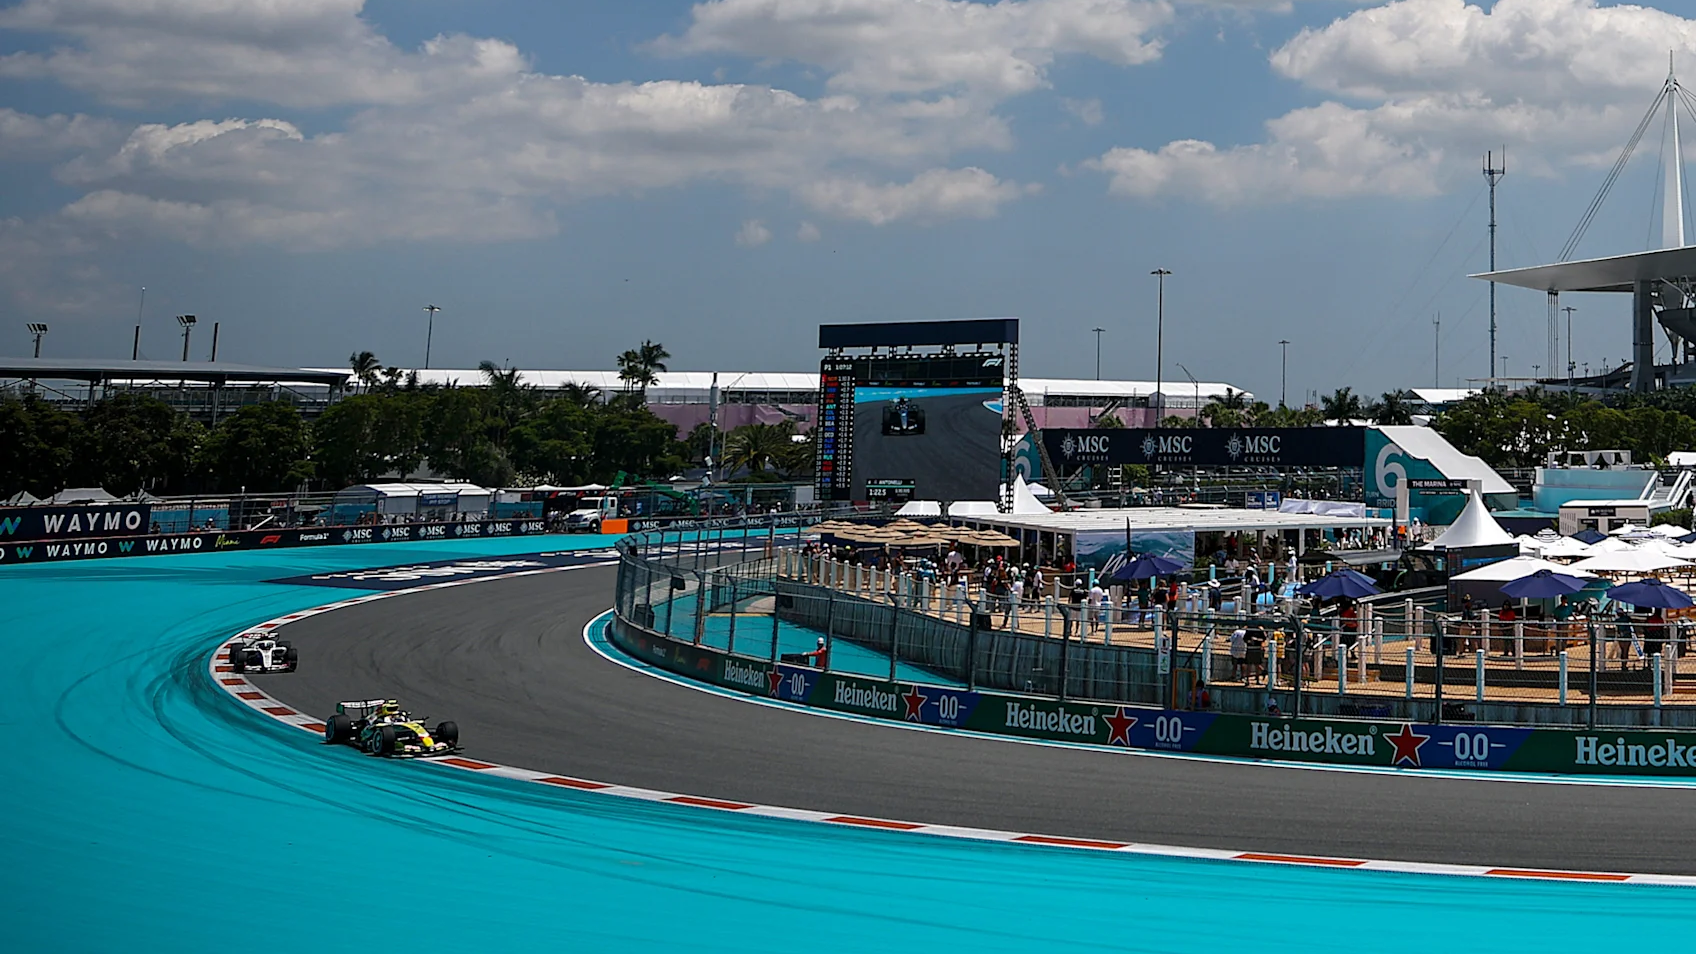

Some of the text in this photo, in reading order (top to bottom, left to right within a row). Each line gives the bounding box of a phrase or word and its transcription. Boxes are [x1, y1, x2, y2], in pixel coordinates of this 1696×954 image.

[1077, 435, 1110, 453] MSC
[1158, 436, 1192, 454] MSC
[1245, 435, 1281, 454] MSC
[1244, 455, 1281, 463] CRUISES
[1375, 443, 1407, 499] 6
[43, 511, 142, 534] WAYMO
[426, 525, 446, 535] MSC
[462, 524, 481, 534] MSC
[494, 522, 512, 532] MSC
[528, 521, 545, 531] MSC
[352, 528, 373, 539] MSC
[391, 527, 411, 537] MSC
[46, 542, 108, 558] WAYMO
[146, 537, 203, 552] WAYMO
[724, 660, 765, 688] Heineken
[834, 680, 898, 712] Heineken
[1005, 702, 1097, 735] Heineken
[1250, 722, 1375, 755] Heineken
